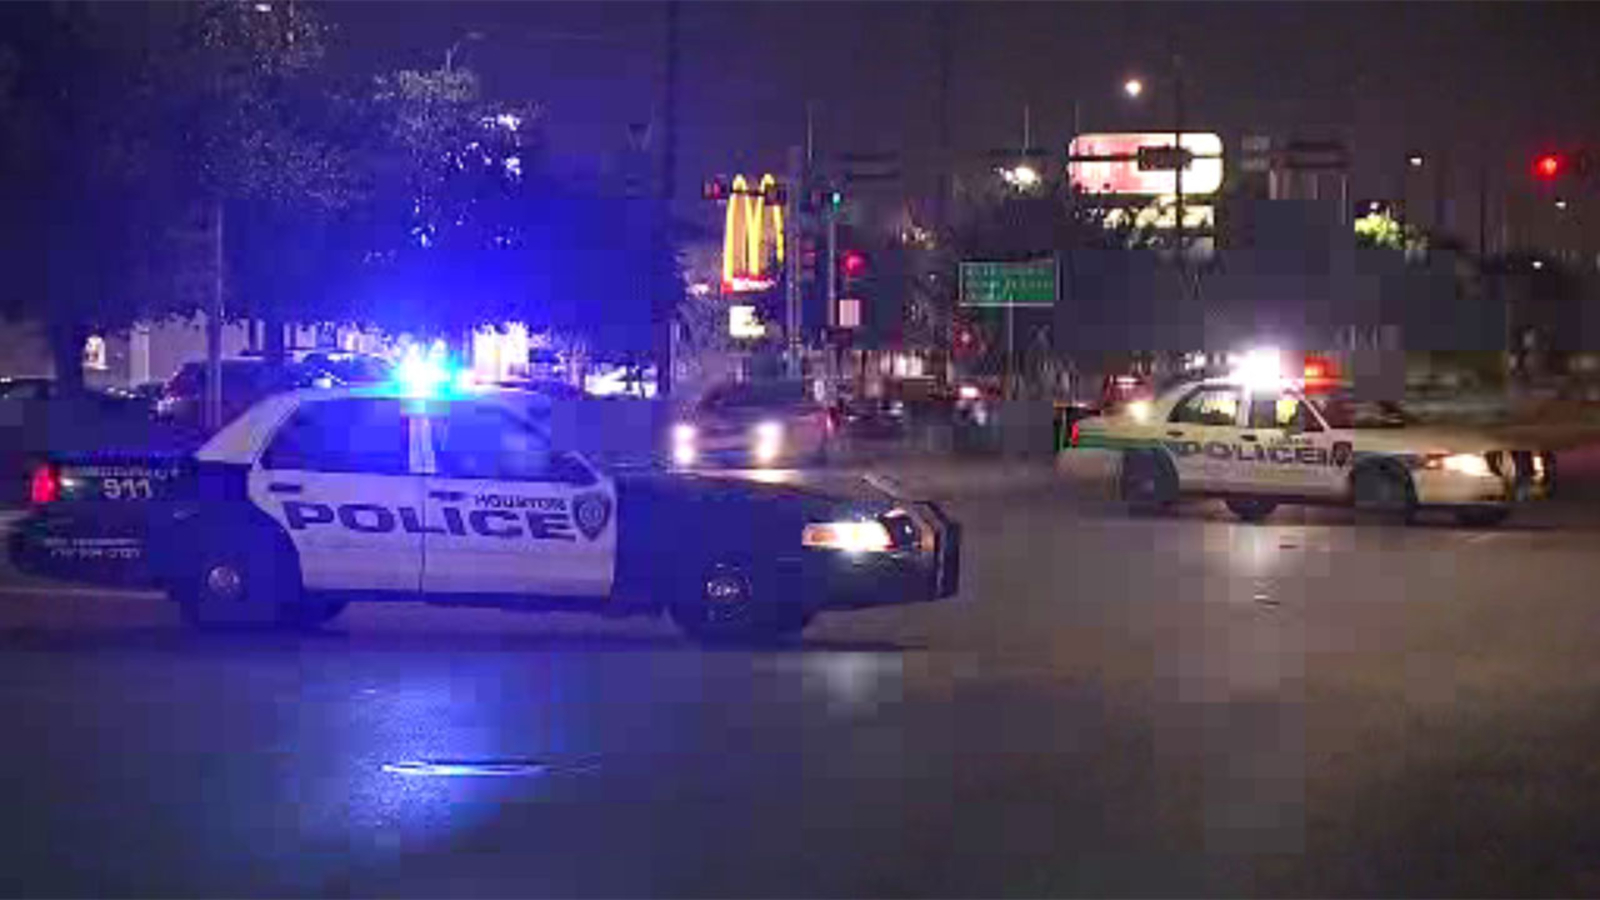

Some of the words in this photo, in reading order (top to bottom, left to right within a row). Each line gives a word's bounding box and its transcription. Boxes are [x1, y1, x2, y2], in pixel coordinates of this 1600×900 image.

[1174, 440, 1327, 465] POLICE
[103, 478, 152, 499] 911
[282, 500, 575, 542] POLICE
